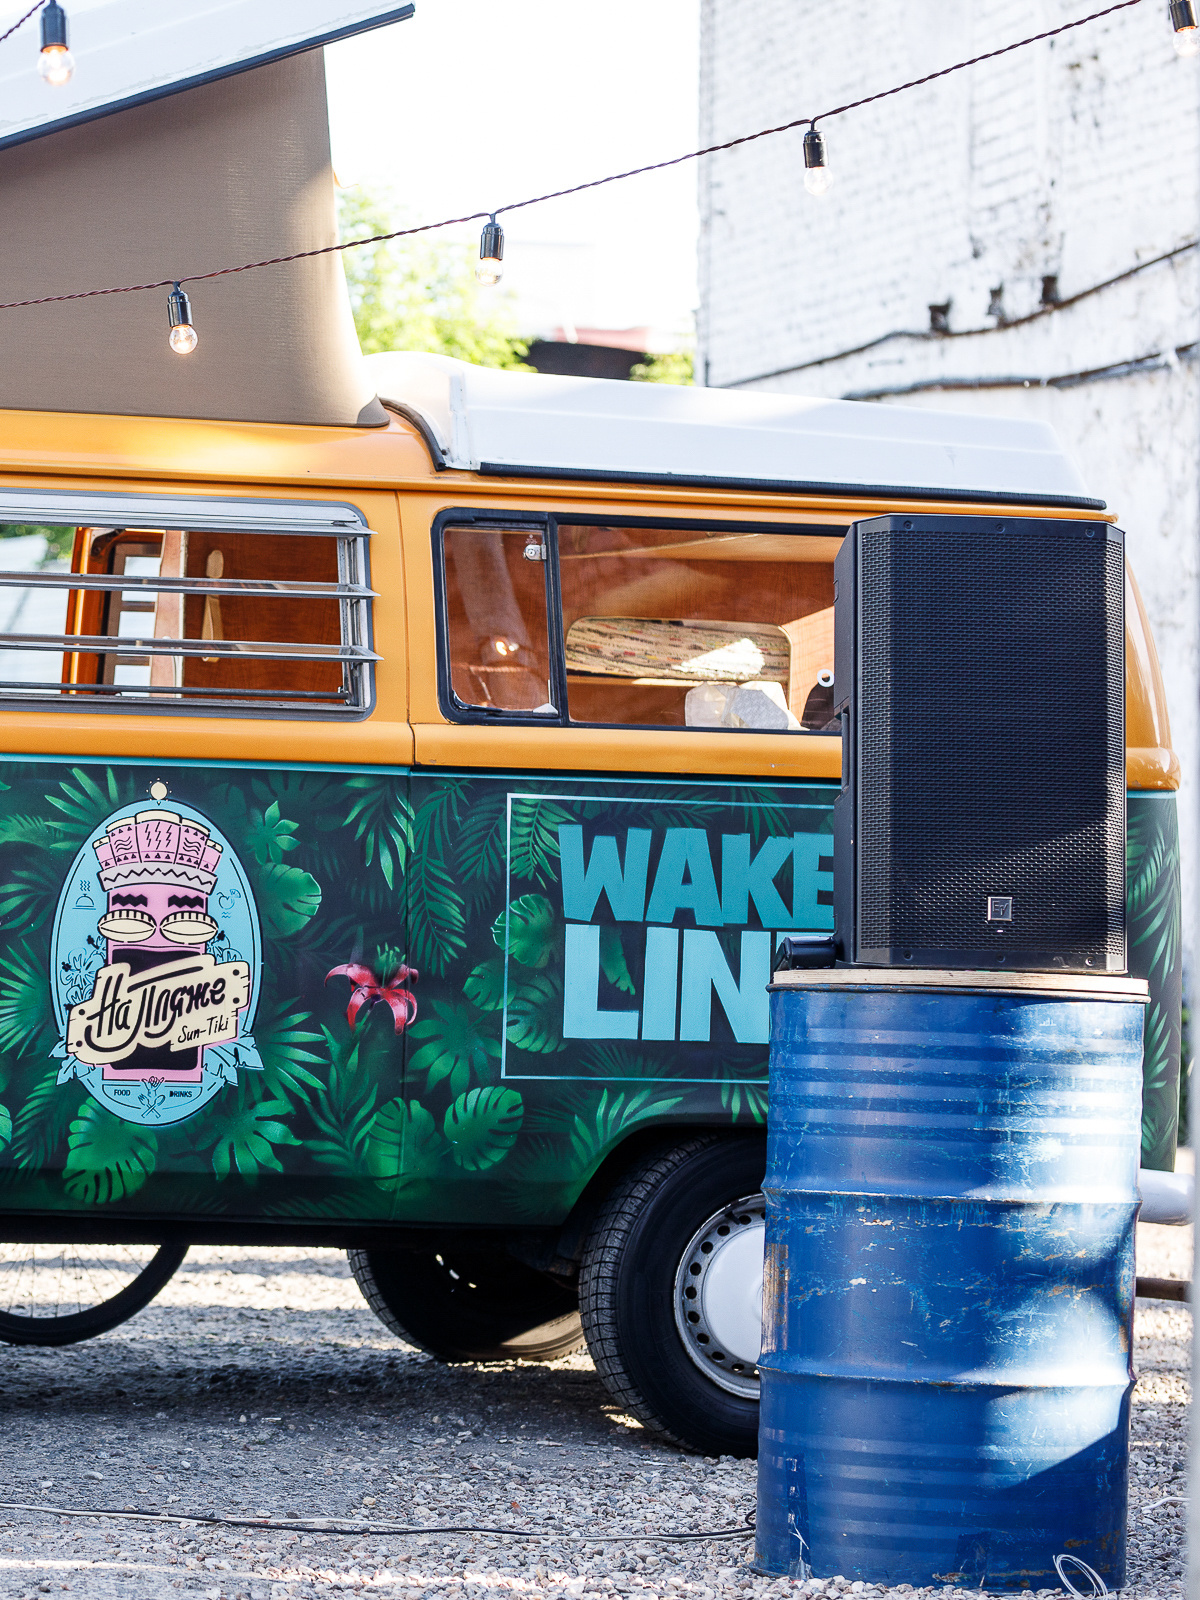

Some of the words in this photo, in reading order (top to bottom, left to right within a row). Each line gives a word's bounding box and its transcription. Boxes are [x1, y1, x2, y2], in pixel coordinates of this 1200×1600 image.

[558, 824, 834, 930] WAKE
[563, 923, 834, 1043] LIN
[177, 1015, 230, 1043] Sun-Tiki
[113, 1089, 131, 1097] FOOD
[169, 1090, 193, 1098] DRINKS
